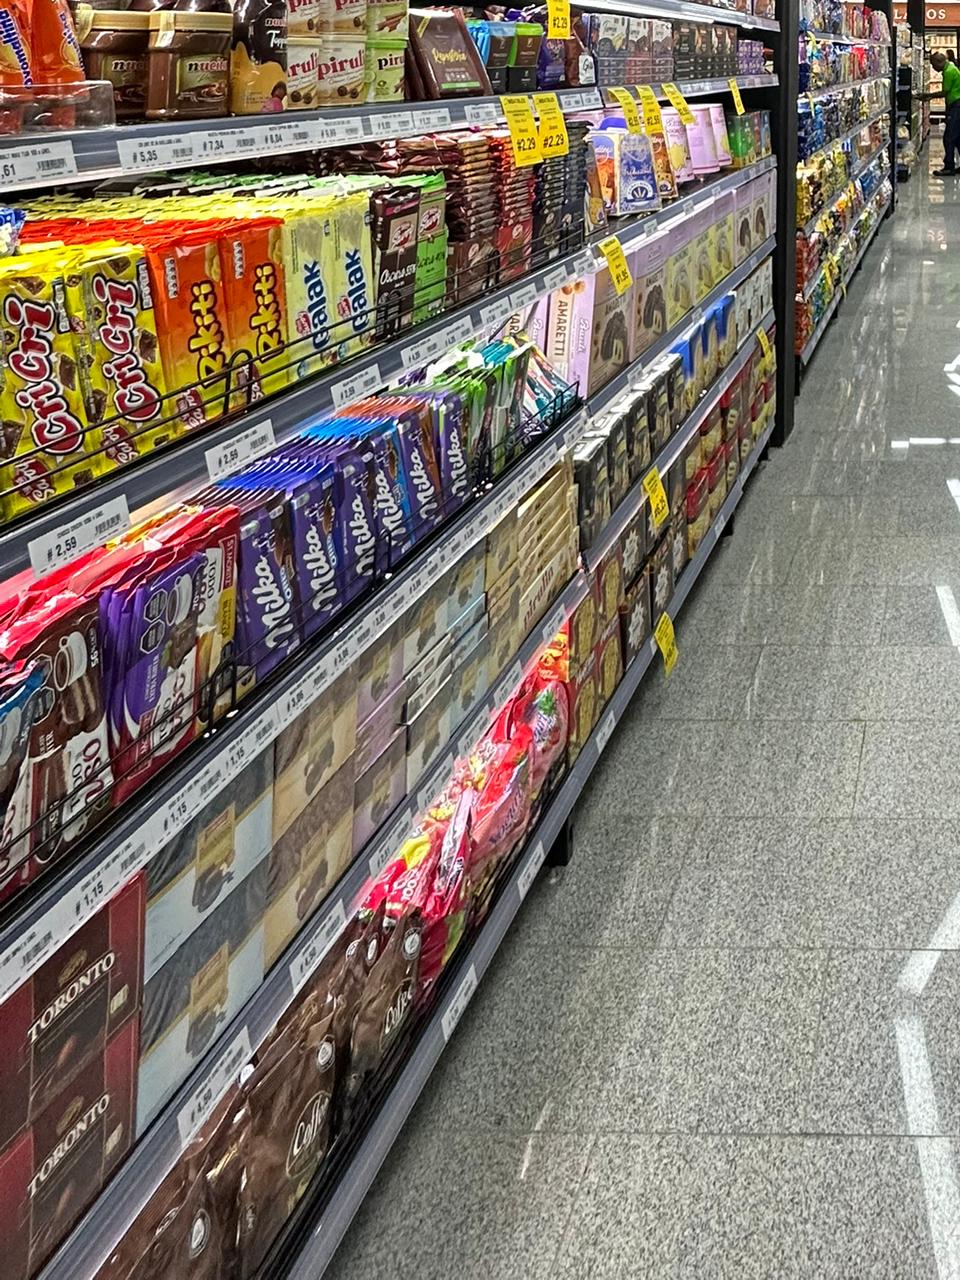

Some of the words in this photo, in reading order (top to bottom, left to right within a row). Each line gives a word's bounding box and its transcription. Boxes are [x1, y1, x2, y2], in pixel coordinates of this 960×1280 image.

[554, 299, 569, 356] AMARETTI
[409, 448, 438, 521] Milka
[55, 536, 77, 558] 2,59
[302, 524, 338, 612] Milka
[349, 493, 376, 577] Milka
[207, 560, 217, 600] TODO
[252, 555, 293, 649] Milka
[170, 802, 188, 822] 1,15
[84, 880, 104, 906] 1,15
[26, 950, 117, 1044] TORONTO
[26, 1093, 111, 1199] TORONTO
